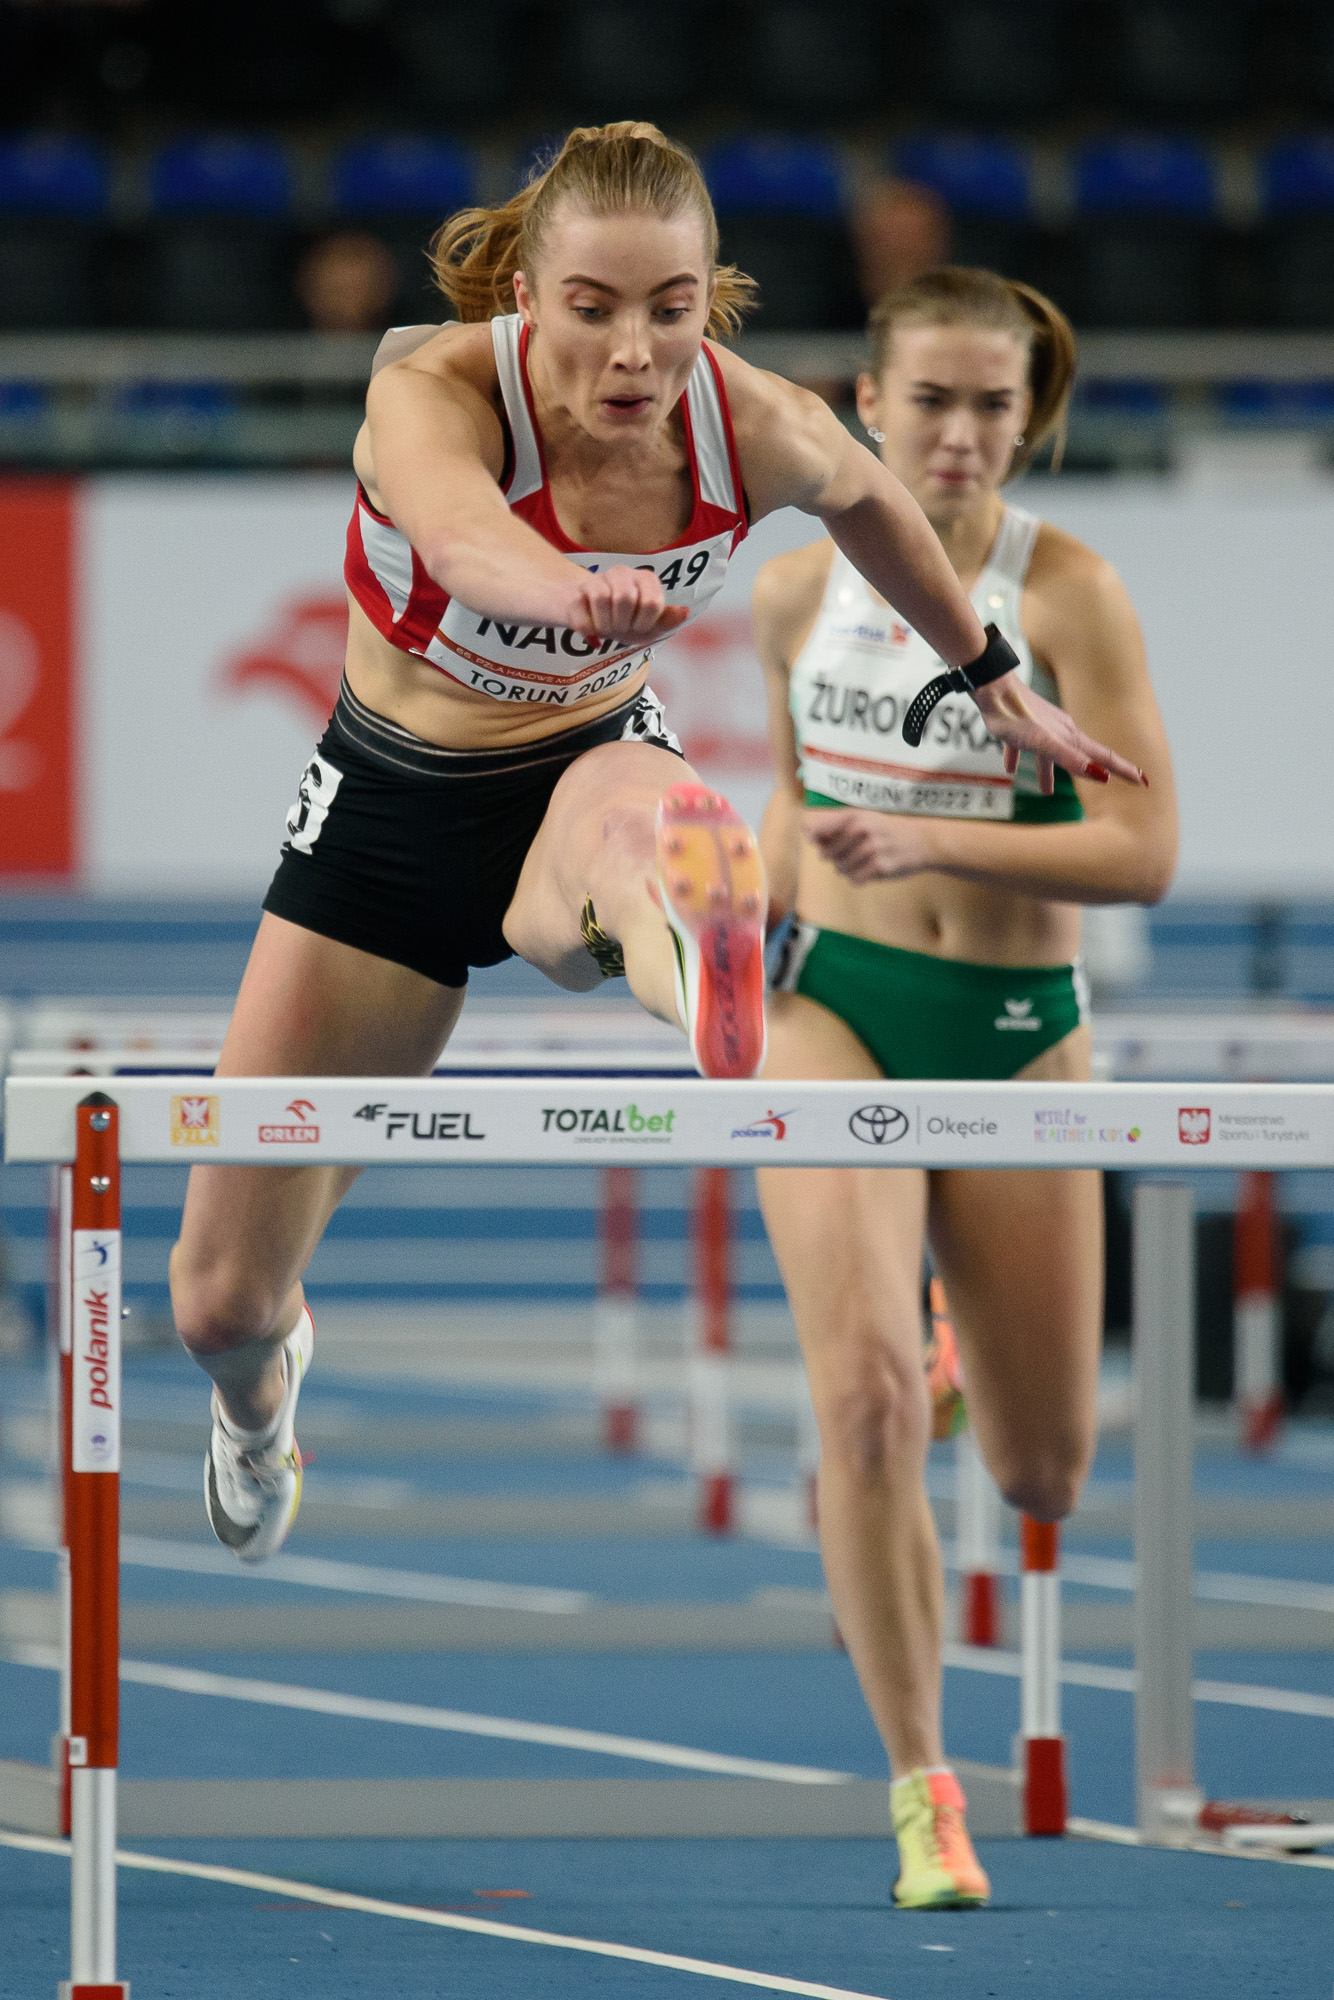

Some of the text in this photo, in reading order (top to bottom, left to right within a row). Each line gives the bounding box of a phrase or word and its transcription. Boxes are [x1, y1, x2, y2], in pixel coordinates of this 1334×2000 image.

[634, 550, 710, 590] 49
[476, 617, 628, 657] NAG
[469, 662, 632, 704] TORUŃ 2022
[505, 666, 553, 683] HALOWE
[807, 671, 1004, 753] ŻUROSKA
[261, 1128, 317, 1141] ORLEN
[353, 1104, 486, 1139] 4F FUEL
[541, 1104, 676, 1133] TOTALbet
[927, 1117, 998, 1139] Okęcie
[83, 1288, 113, 1410] polanik
